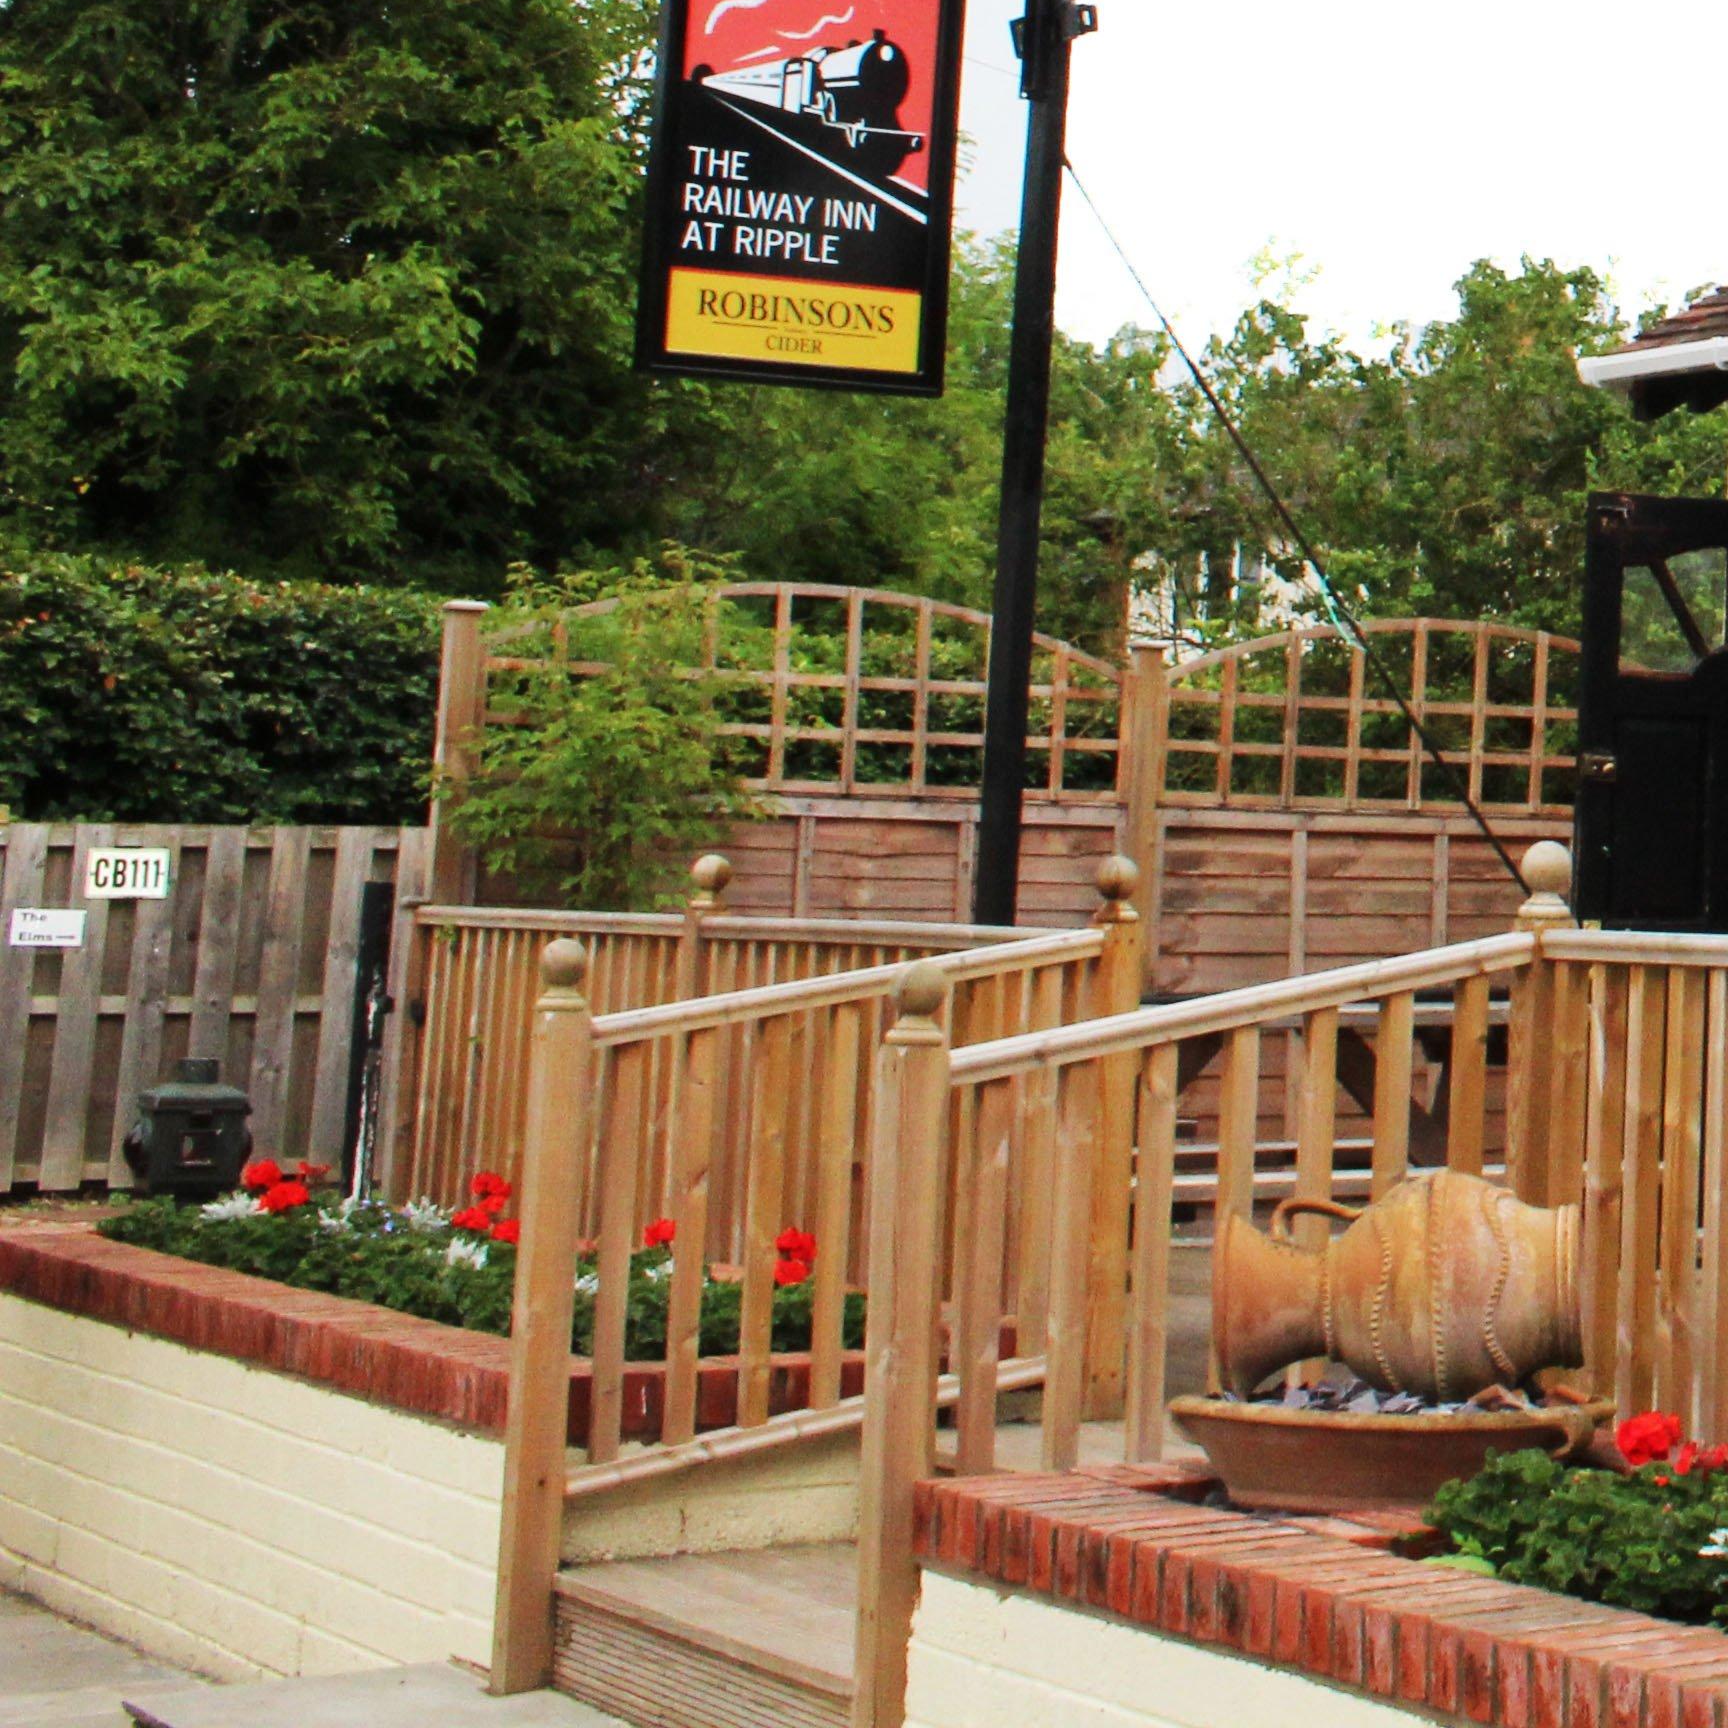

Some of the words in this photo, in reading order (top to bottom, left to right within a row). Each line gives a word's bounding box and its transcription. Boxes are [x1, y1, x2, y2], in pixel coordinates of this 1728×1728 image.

[688, 145, 750, 181] THE
[683, 182, 814, 224] RAILWAY
[824, 198, 876, 232] INN
[681, 220, 724, 252] AT
[734, 225, 840, 264] RIPPLE
[698, 288, 895, 333] ROBINSONS
[765, 335, 823, 354] CIDER
[95, 858, 160, 888] CB111
[22, 912, 47, 921] The
[18, 932, 53, 941] Elms
